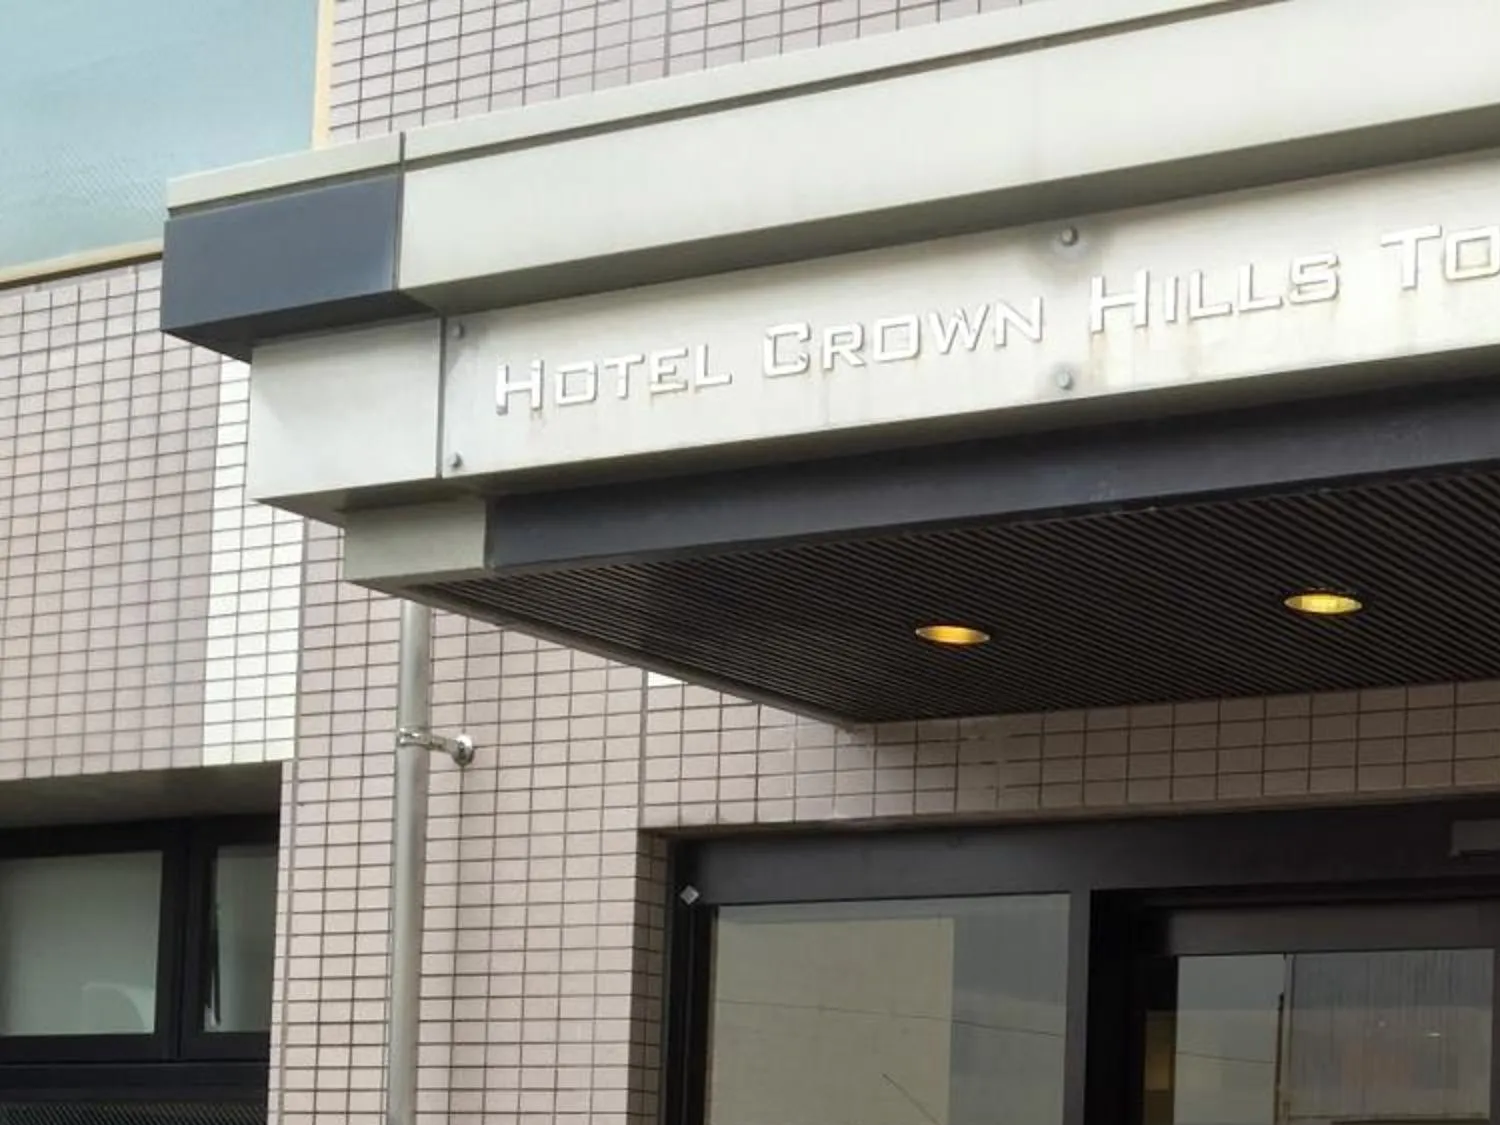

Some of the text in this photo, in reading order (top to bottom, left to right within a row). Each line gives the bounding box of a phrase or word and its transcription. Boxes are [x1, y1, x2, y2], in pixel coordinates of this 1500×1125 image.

[495, 340, 732, 416] HOTEL
[762, 294, 1043, 376] CROWN
[1090, 250, 1341, 335] HILLS
